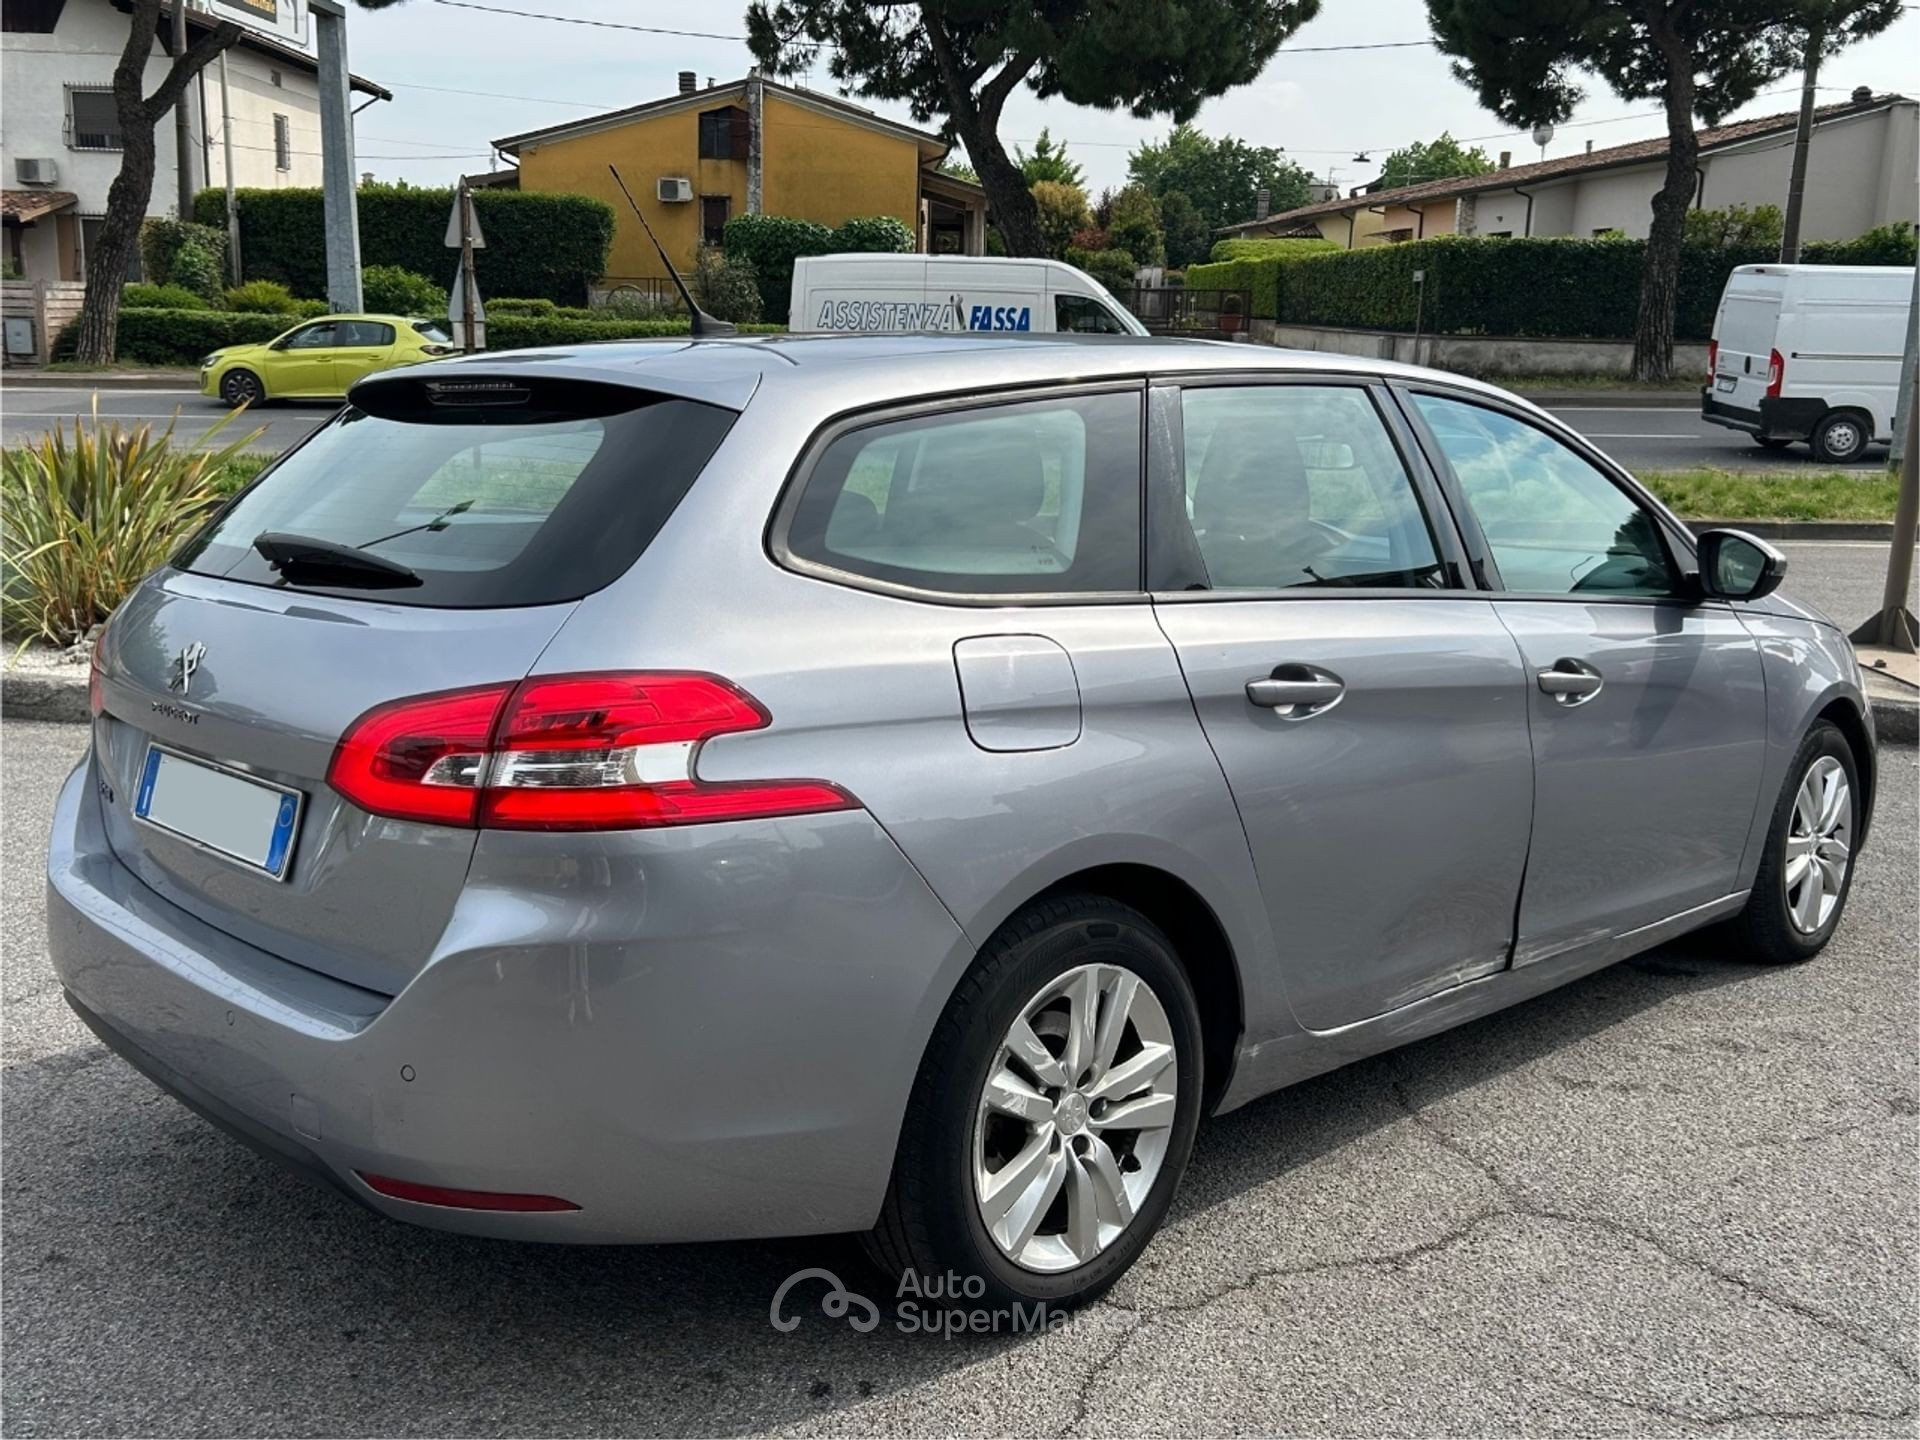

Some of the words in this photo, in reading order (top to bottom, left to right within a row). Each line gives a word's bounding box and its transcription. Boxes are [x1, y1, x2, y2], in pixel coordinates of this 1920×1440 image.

[817, 300, 956, 331] ASSISTENZA
[969, 306, 1030, 331] FASSA
[151, 701, 200, 725] PEUGEOT
